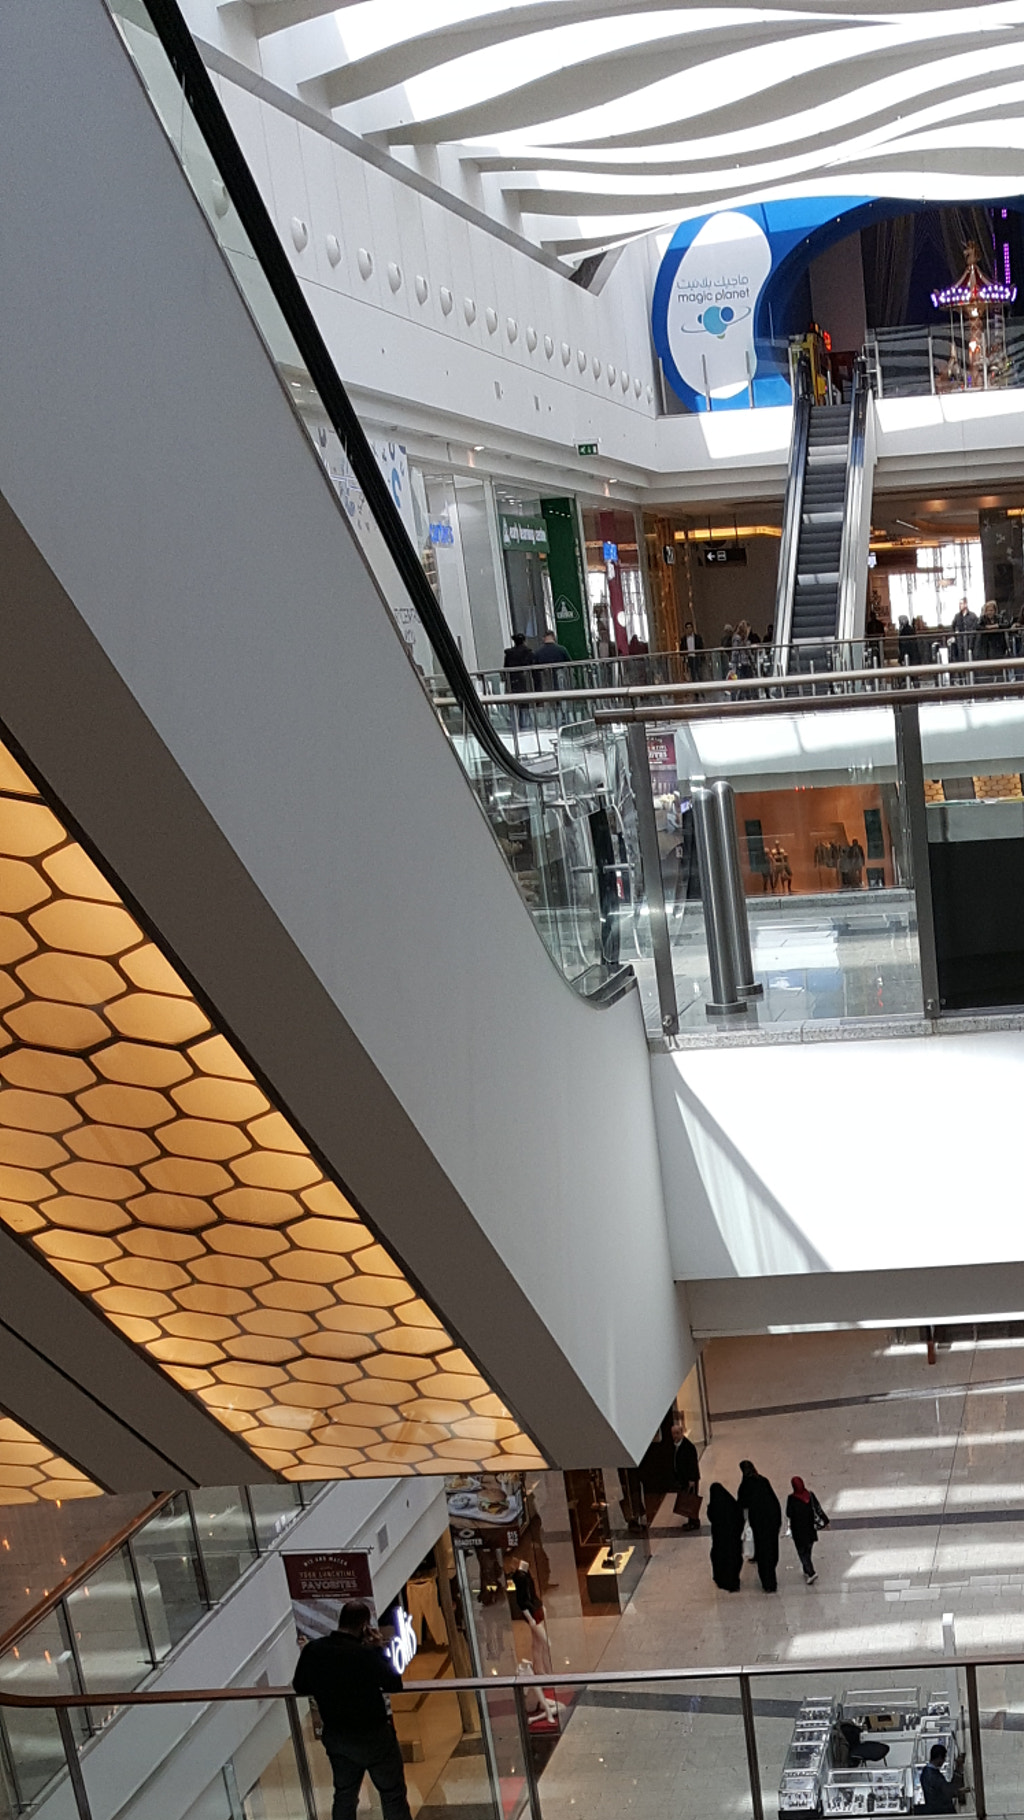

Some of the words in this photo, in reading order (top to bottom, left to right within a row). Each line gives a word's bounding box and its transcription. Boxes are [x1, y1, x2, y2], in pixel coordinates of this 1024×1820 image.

[714, 275, 749, 289] ماجيك
[678, 291, 713, 304] magic
[715, 288, 749, 303] planet
[301, 1580, 358, 1590] FAVORITES
